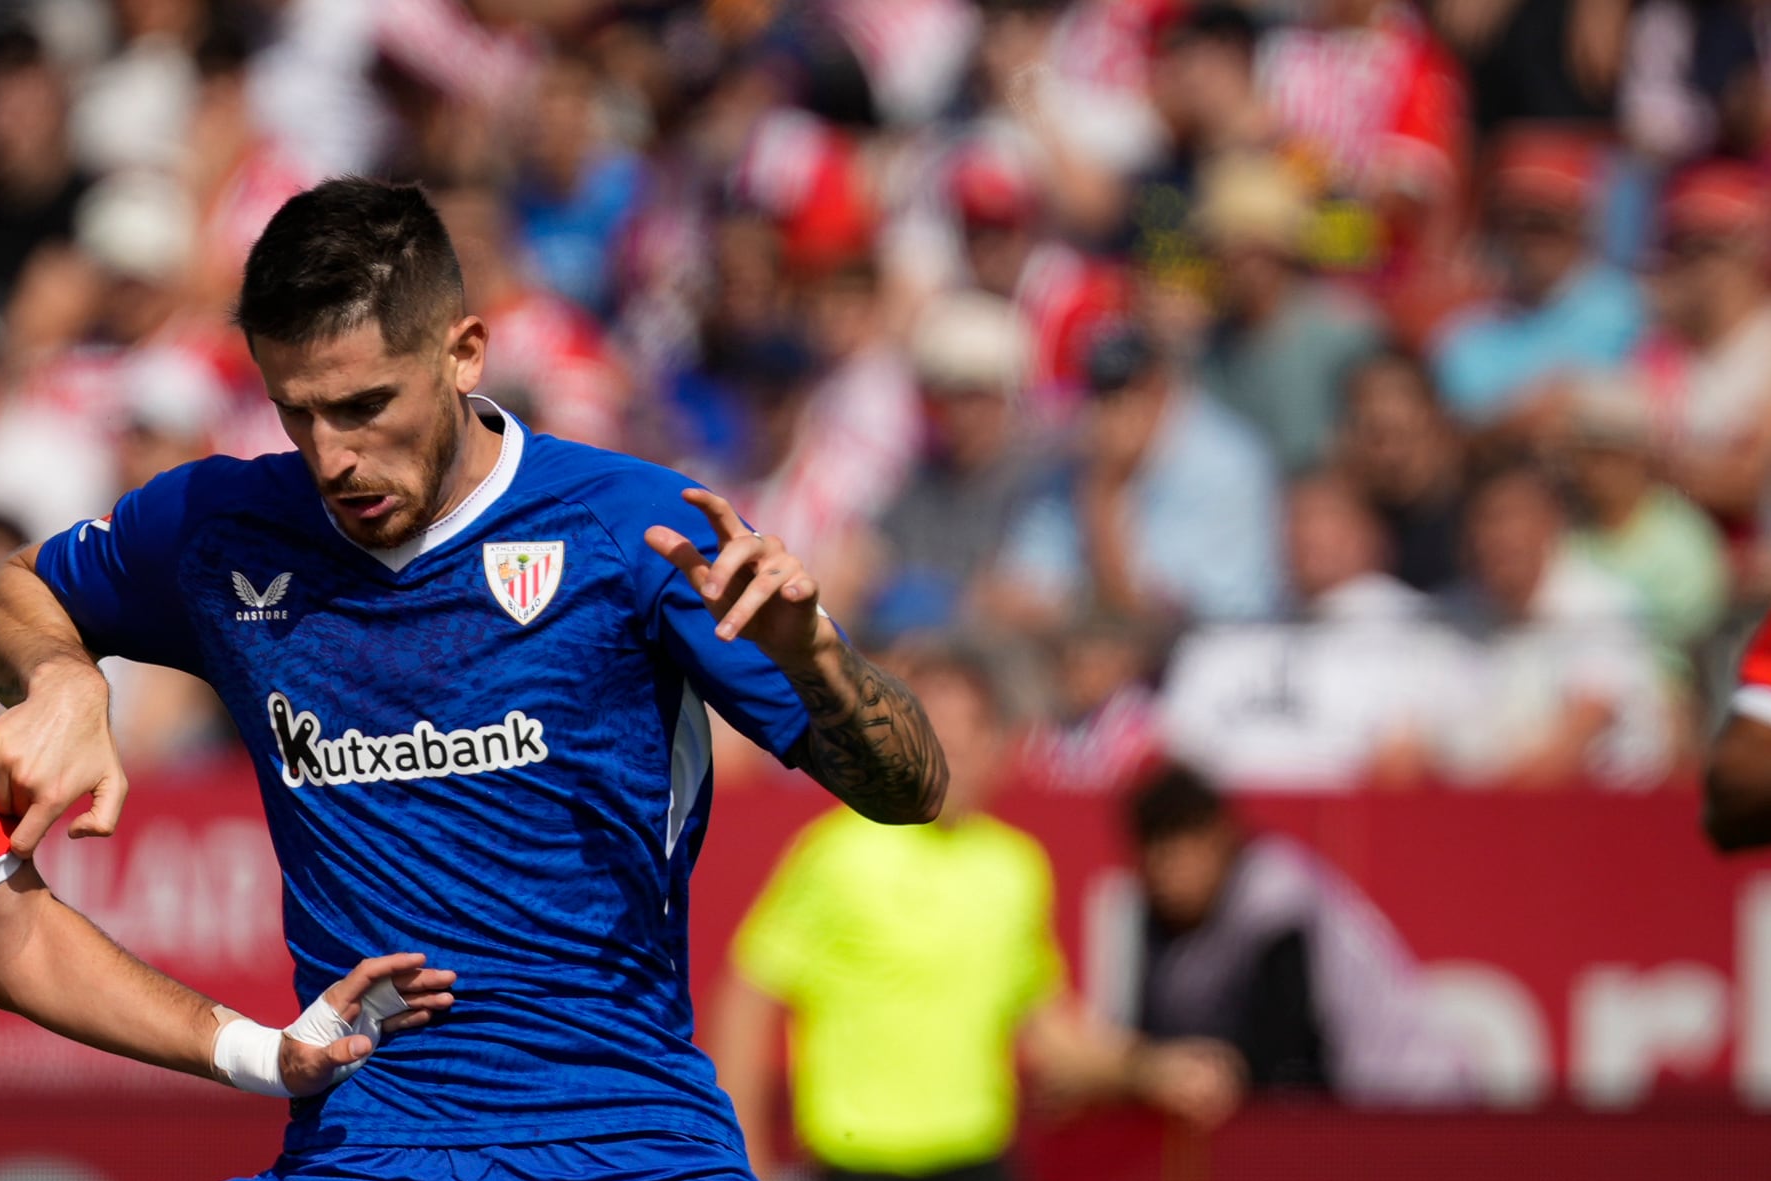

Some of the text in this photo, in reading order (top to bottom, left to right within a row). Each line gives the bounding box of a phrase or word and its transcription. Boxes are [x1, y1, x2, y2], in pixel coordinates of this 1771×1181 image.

[235, 610, 289, 621] CASTORE
[508, 598, 541, 620] BILBAO
[269, 693, 544, 784] Kutxabank
